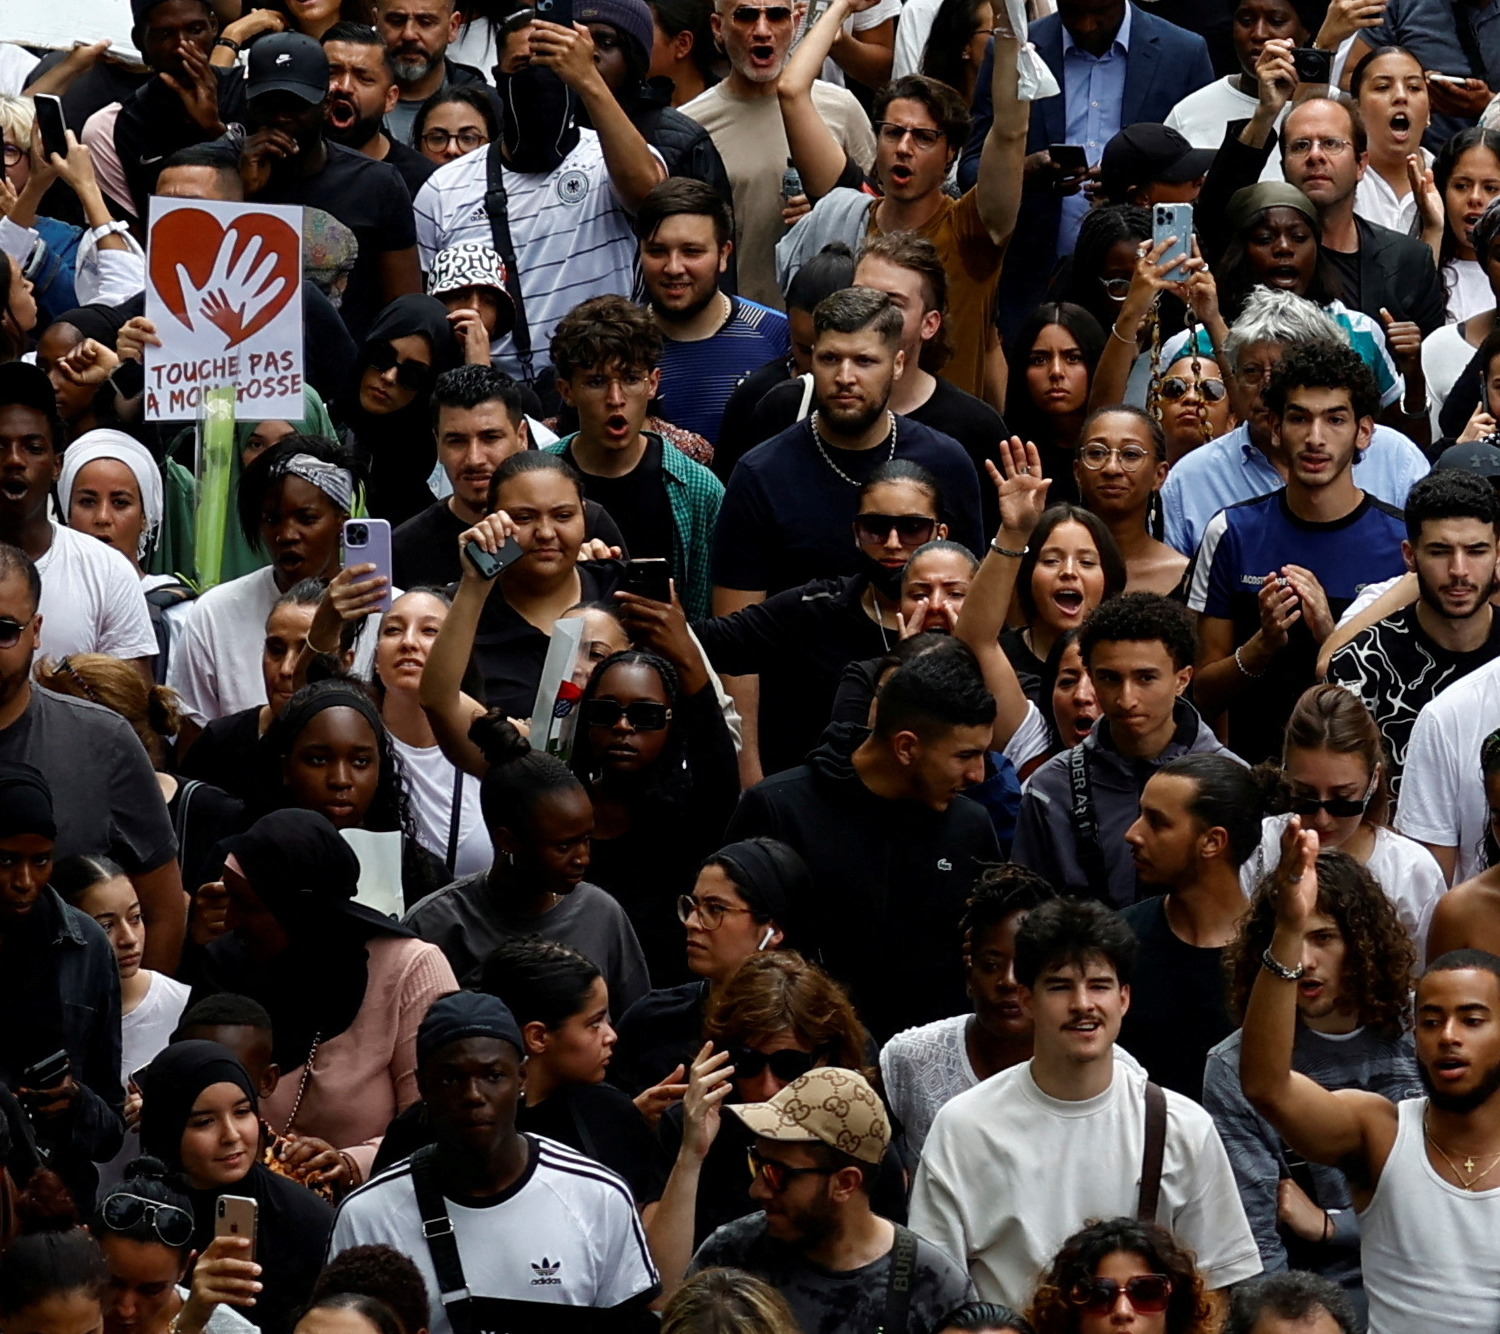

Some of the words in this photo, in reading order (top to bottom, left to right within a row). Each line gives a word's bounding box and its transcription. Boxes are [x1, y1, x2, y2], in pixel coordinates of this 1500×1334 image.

[151, 356, 240, 390] TOUCHE
[248, 350, 295, 377] PAS
[146, 386, 161, 418] À
[531, 1277, 562, 1286] adidas
